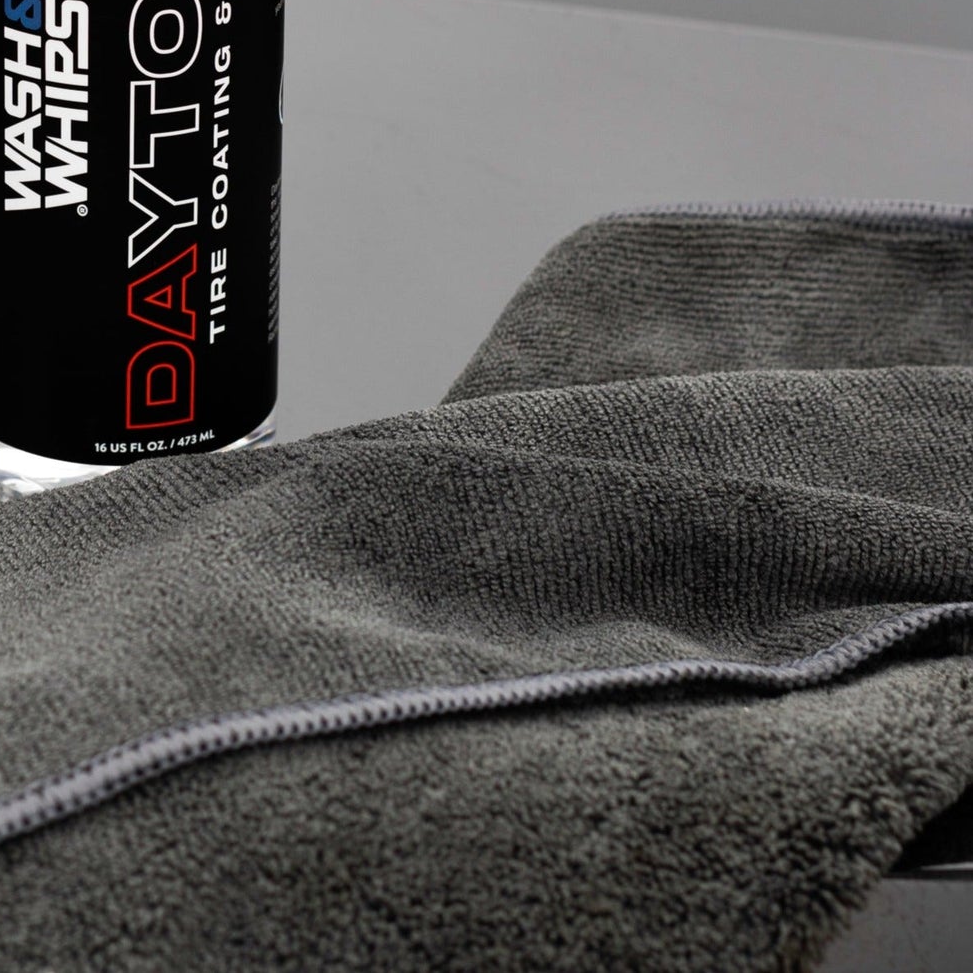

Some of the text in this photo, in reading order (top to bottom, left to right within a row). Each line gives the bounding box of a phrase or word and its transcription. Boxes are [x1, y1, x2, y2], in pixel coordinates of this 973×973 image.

[215, 1, 232, 26] &
[212, 45, 231, 230] COATING
[210, 248, 227, 345] TIRE
[94, 442, 107, 453] 16
[110, 442, 127, 453] US
[130, 442, 144, 453] FL
[147, 440, 167, 451] OZ.
[177, 434, 197, 447] 473
[199, 429, 215, 442] ML
